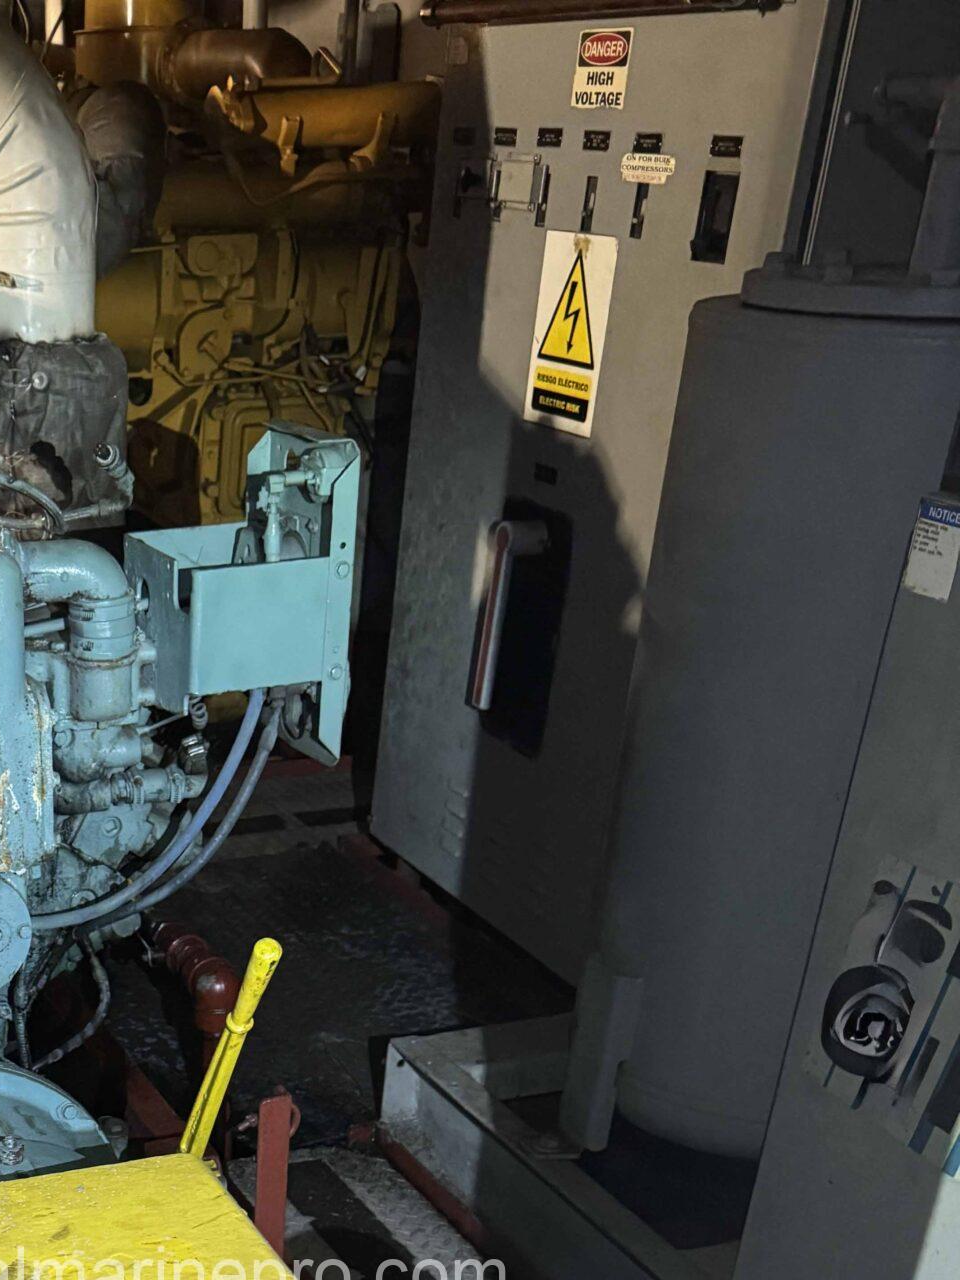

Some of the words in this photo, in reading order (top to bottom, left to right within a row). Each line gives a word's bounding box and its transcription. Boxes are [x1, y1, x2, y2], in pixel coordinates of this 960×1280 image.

[584, 40, 624, 57] DANGER
[586, 71, 615, 86] HIGH
[575, 91, 623, 106] VOLTAGE
[621, 164, 673, 173] COMPRESSORS
[539, 395, 565, 409] ELECTRIC
[929, 506, 960, 525] NOTICE
